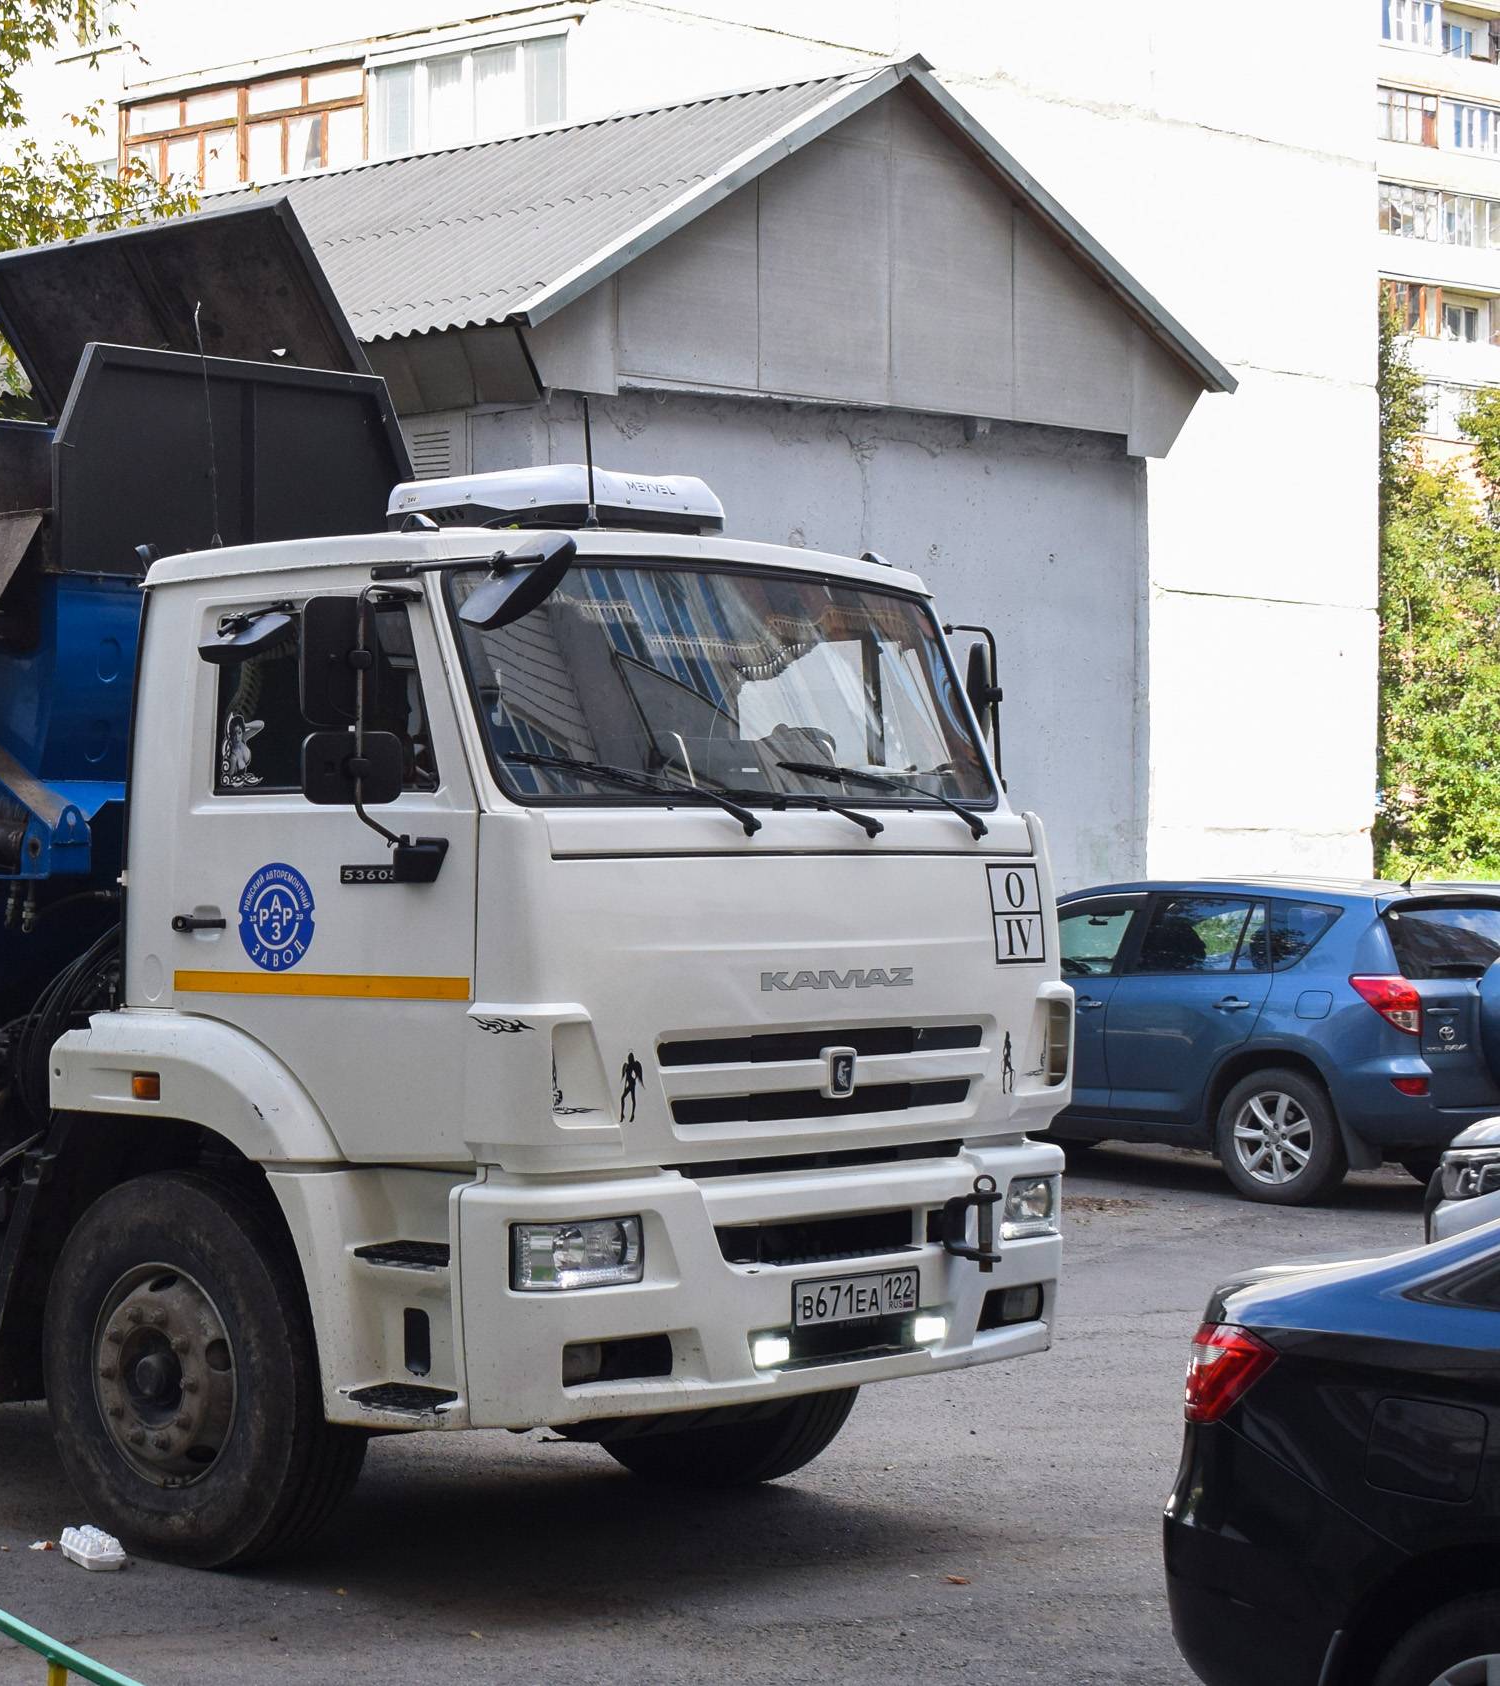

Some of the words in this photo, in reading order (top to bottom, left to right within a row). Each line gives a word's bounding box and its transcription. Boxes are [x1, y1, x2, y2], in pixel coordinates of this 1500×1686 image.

[625, 480, 676, 496] MEYVEL
[243, 873, 265, 912] РЯЖСКИЙ
[265, 869, 311, 910] АВТОРЕМОНТНЫЙ
[1004, 917, 1033, 957] IV
[252, 939, 305, 968] ЗАВОД
[760, 967, 913, 991] KAMAZ
[884, 1275, 912, 1300] 122
[889, 1301, 903, 1309] RUS
